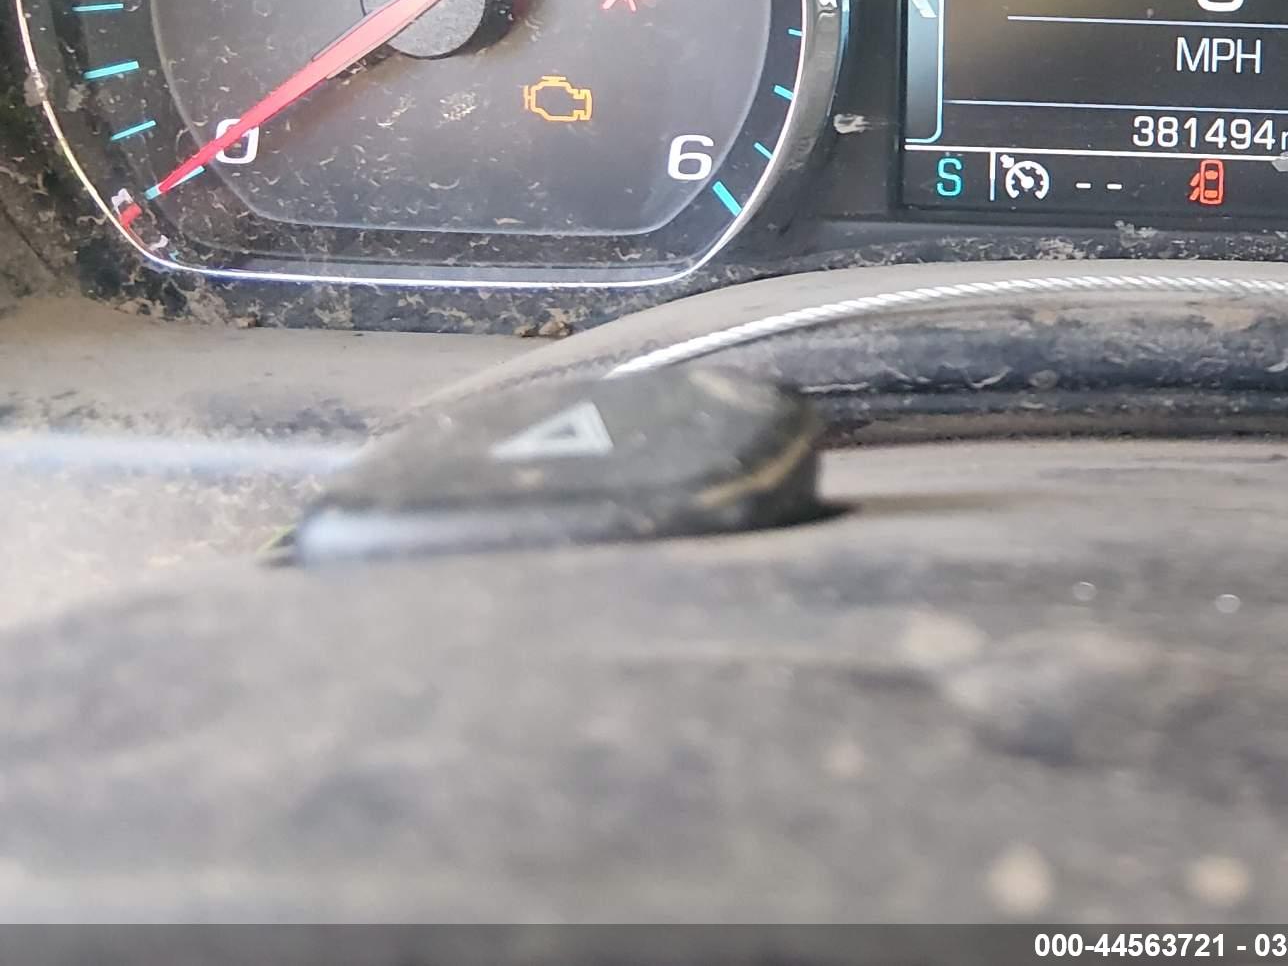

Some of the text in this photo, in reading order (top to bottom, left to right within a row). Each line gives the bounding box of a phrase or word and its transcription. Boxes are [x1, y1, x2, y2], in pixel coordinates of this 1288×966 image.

[1176, 38, 1261, 74] MPH
[667, 134, 713, 181] 6
[938, 158, 963, 196] S
